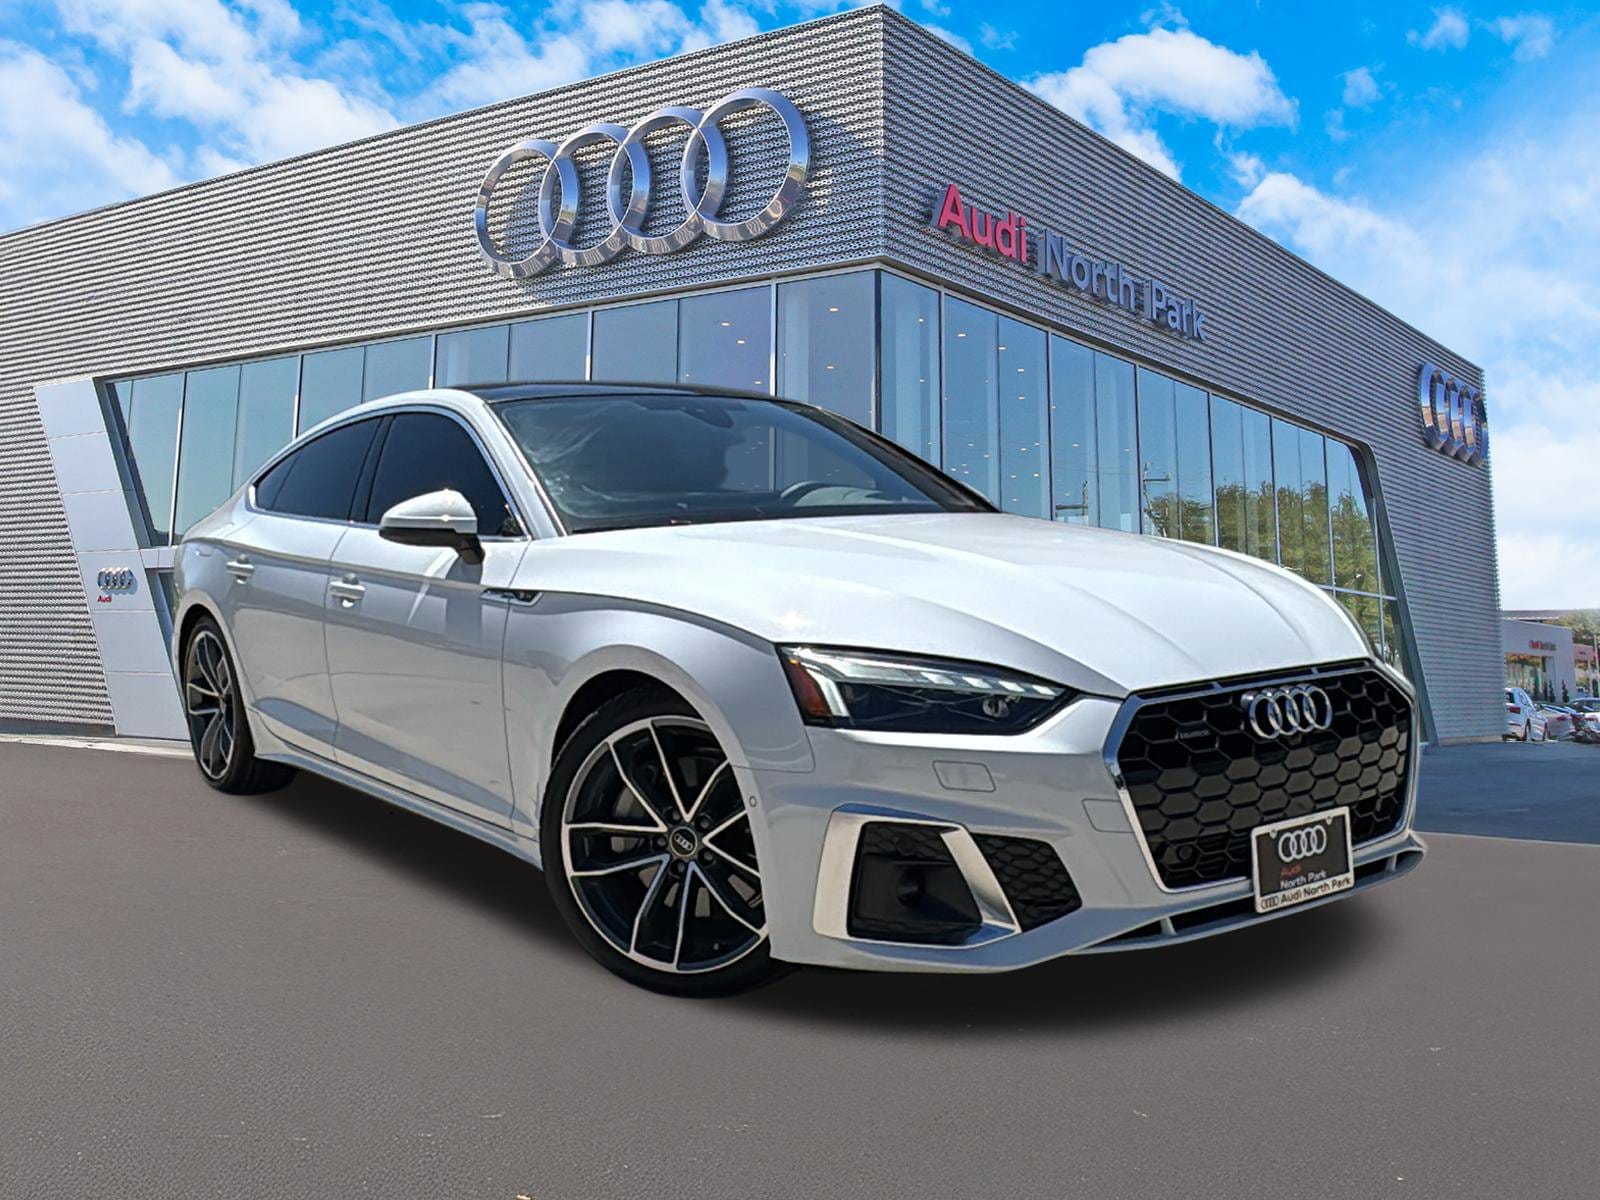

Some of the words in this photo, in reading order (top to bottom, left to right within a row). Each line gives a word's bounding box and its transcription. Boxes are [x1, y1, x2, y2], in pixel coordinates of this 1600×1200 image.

[933, 183, 1028, 263] Audi
[1038, 229, 1137, 310] North
[1144, 279, 1208, 341] Park
[1280, 876, 1307, 890] North
[1308, 869, 1327, 882] Park
[1281, 892, 1302, 904] Audi
[1304, 883, 1331, 897] North
[1332, 876, 1351, 889] Park
